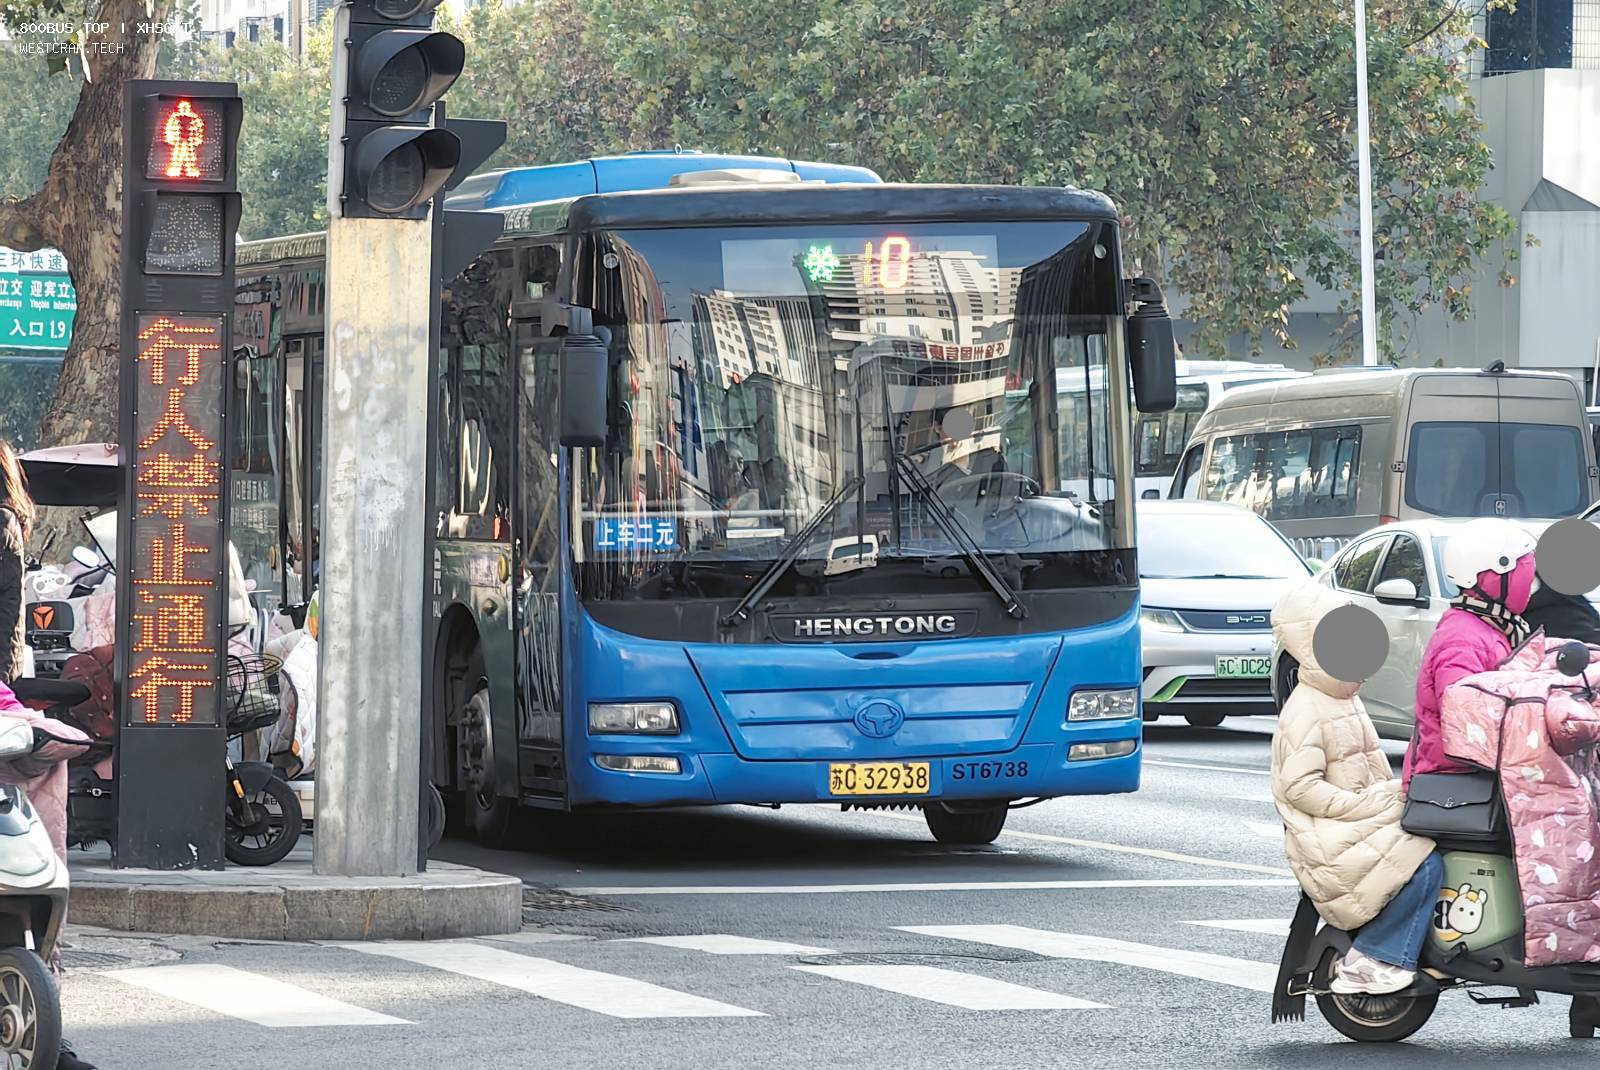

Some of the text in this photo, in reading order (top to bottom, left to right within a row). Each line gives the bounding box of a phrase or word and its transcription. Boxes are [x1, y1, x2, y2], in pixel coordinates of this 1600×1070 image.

[863, 236, 910, 288] 10
[30, 279, 76, 299] 迎宾立
[9, 318, 43, 337] 入口
[129, 317, 220, 724] 行人禁止通行
[598, 521, 674, 546] 上车二元
[794, 615, 956, 636] HENGTONG
[1226, 615, 1266, 623] BYD
[952, 761, 1028, 780] ST6738
